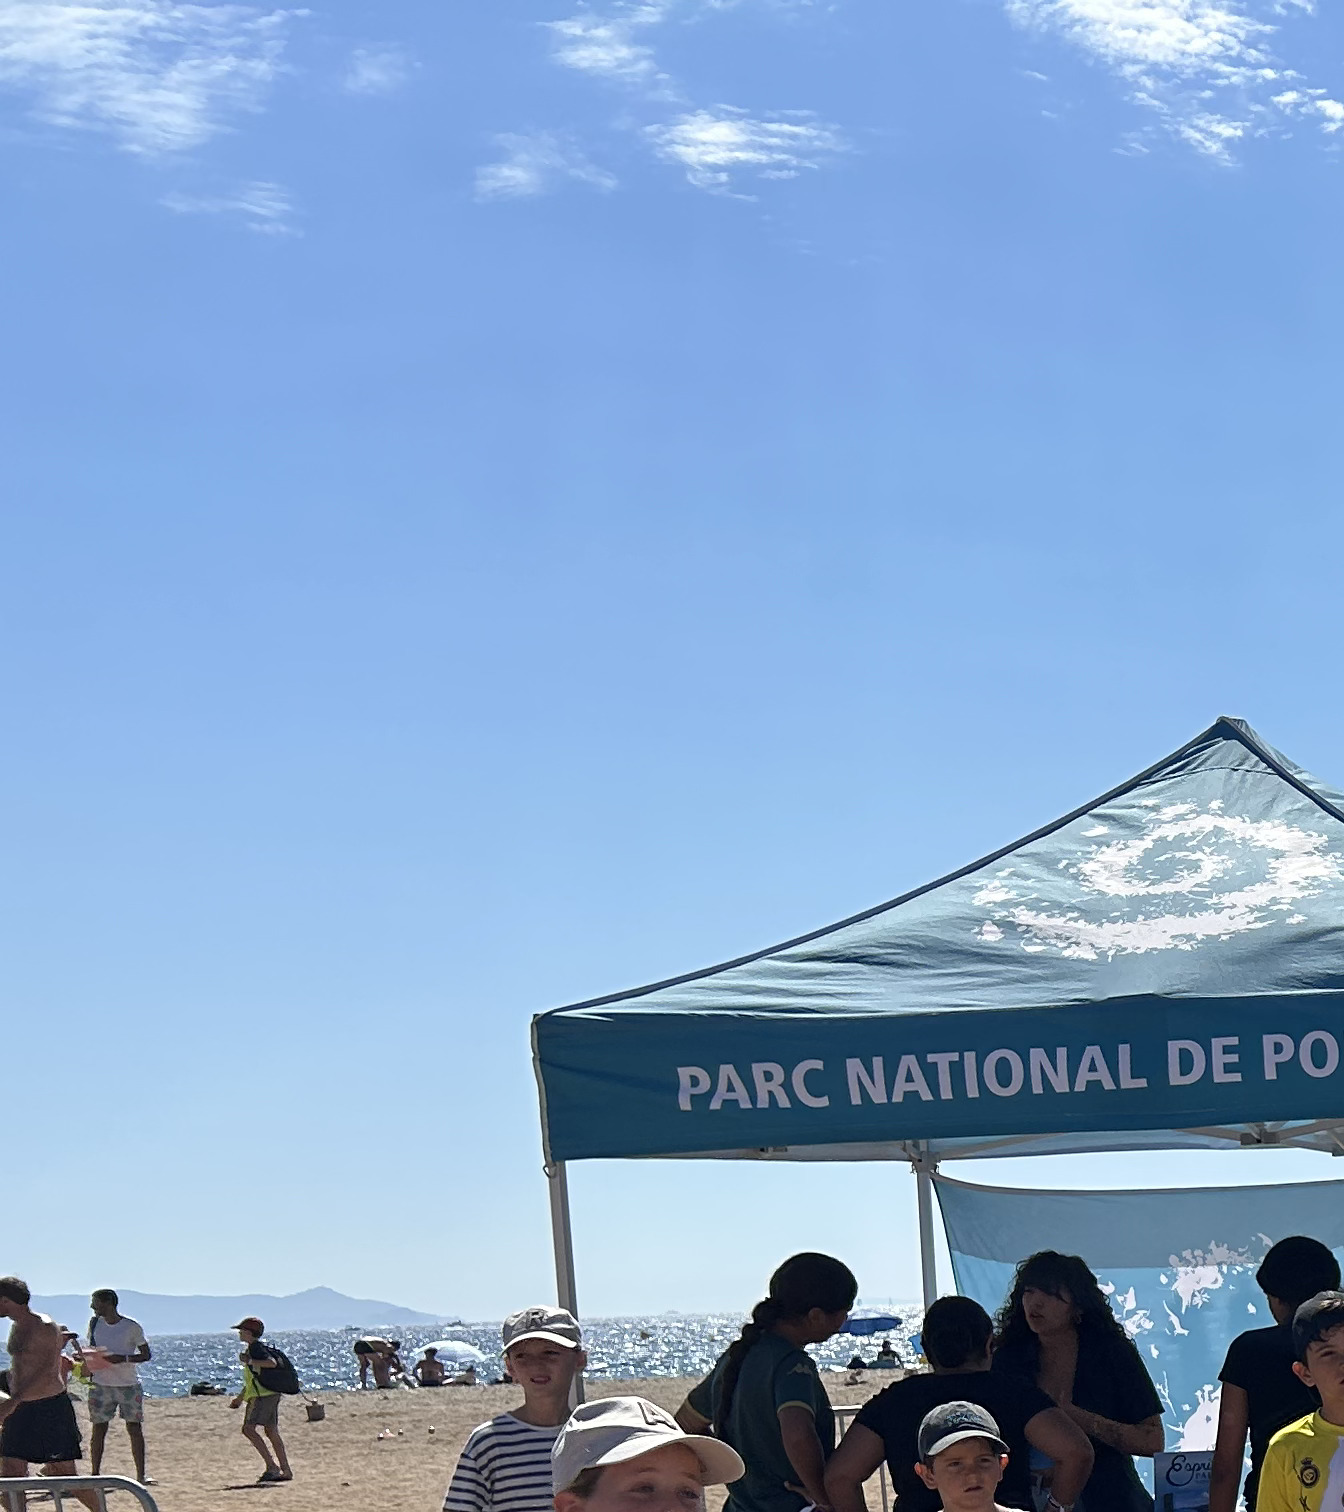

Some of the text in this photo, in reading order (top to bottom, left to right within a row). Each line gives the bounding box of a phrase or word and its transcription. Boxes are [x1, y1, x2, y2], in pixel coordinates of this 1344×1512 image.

[676, 1059, 829, 1111] PARC
[845, 1043, 1148, 1105] NATIONAL
[1167, 1036, 1242, 1086] DE
